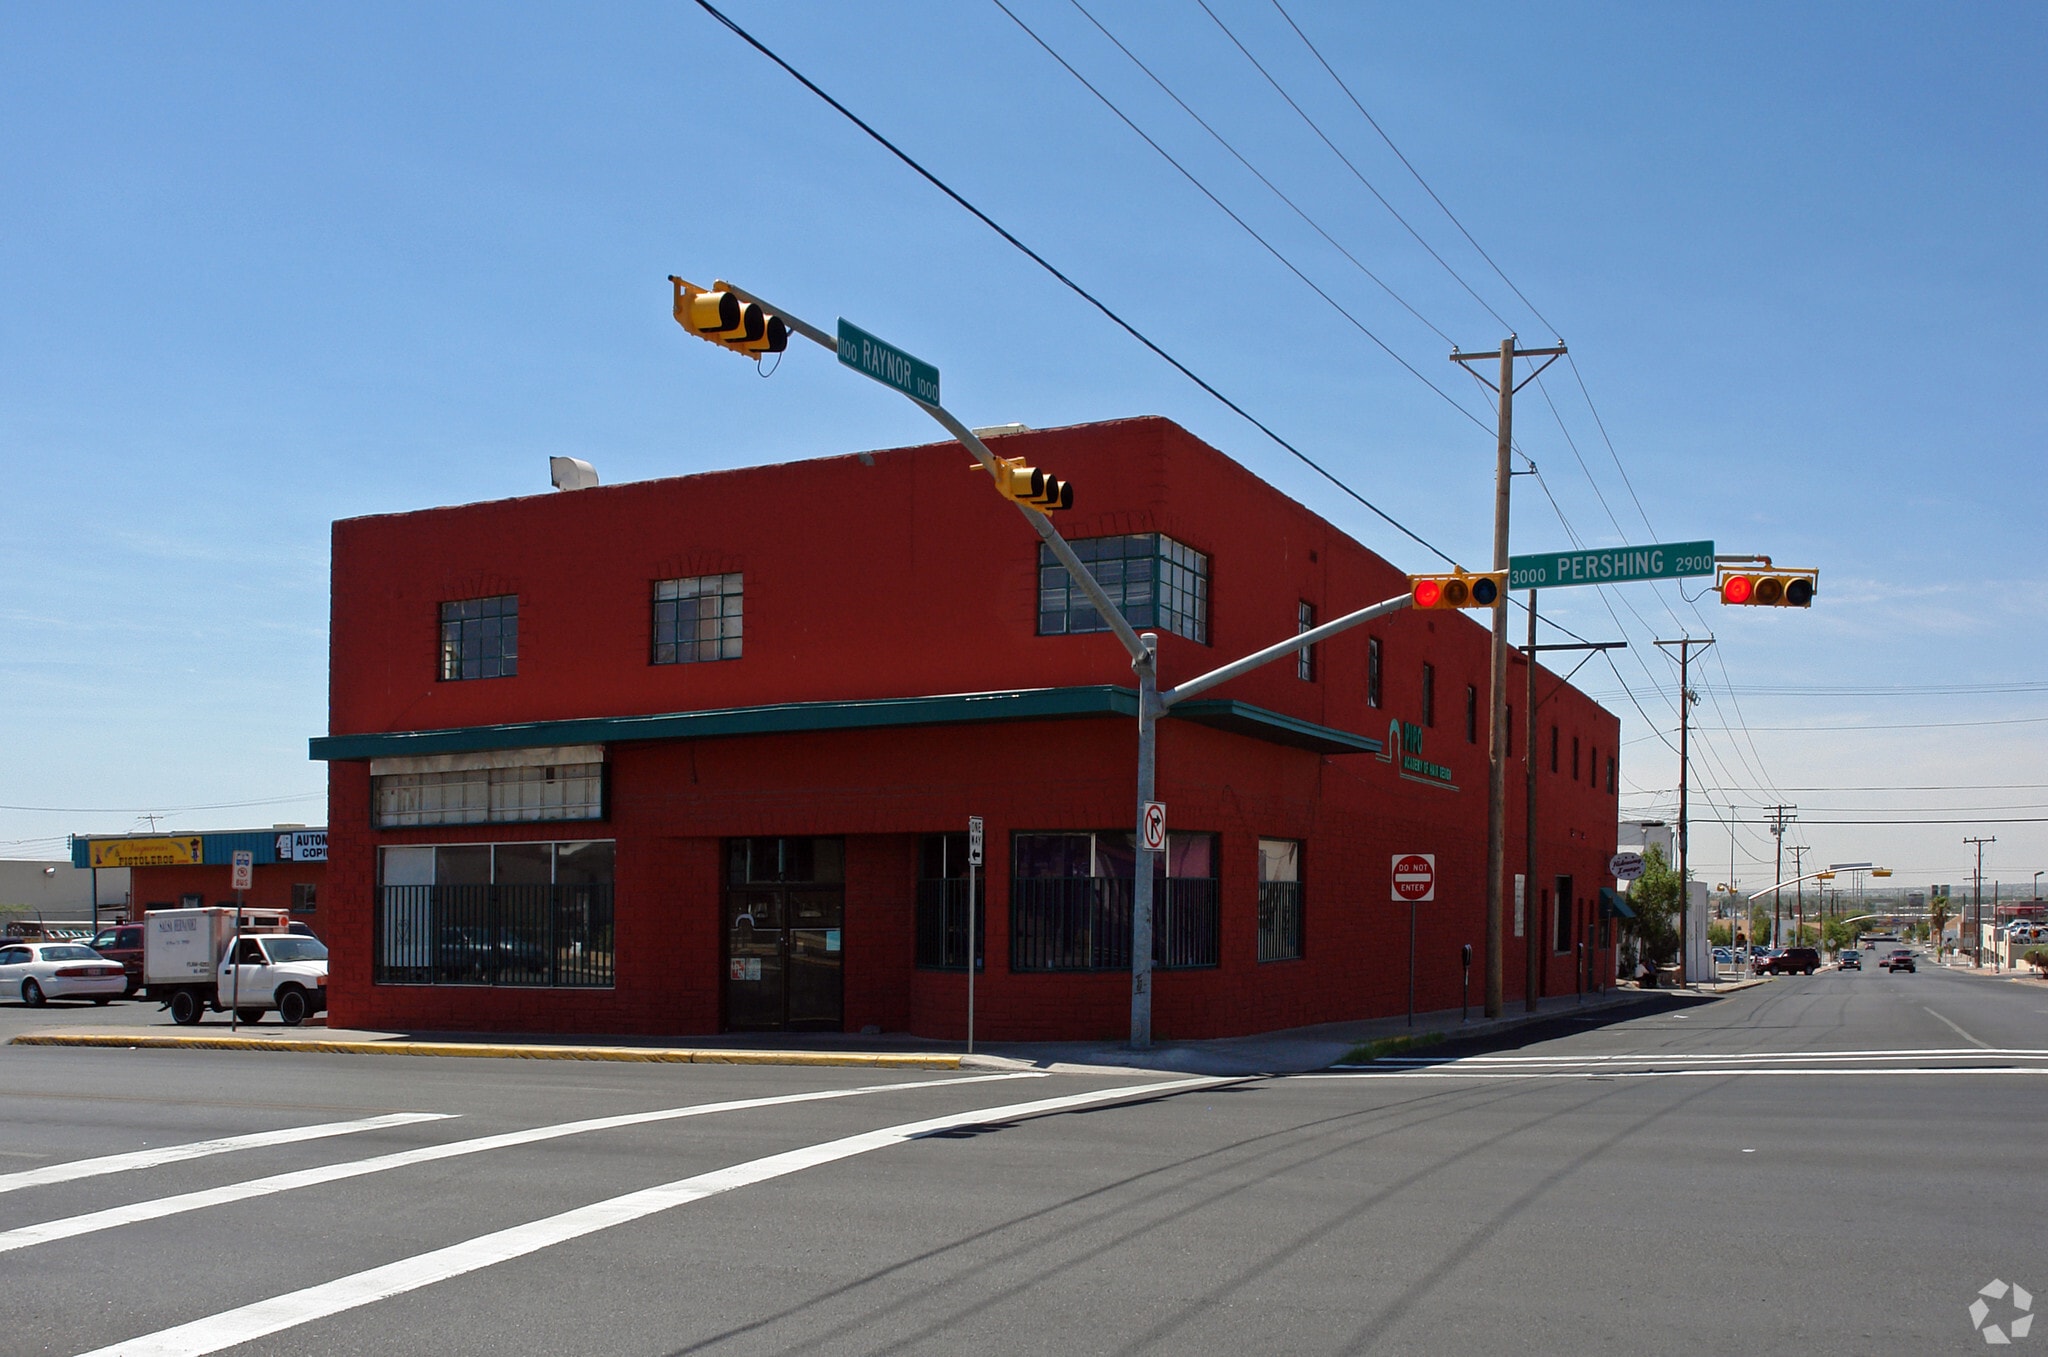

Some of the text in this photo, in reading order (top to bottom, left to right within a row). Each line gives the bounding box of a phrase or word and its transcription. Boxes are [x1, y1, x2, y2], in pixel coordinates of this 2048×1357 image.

[863, 339, 912, 390] RAYNOR
[917, 376, 938, 402] 1000
[1511, 550, 1712, 585] 3000 PERSHING 2900
[971, 821, 982, 833] ONE
[971, 835, 982, 846] WAY
[119, 855, 174, 866] PISTOLEROS
